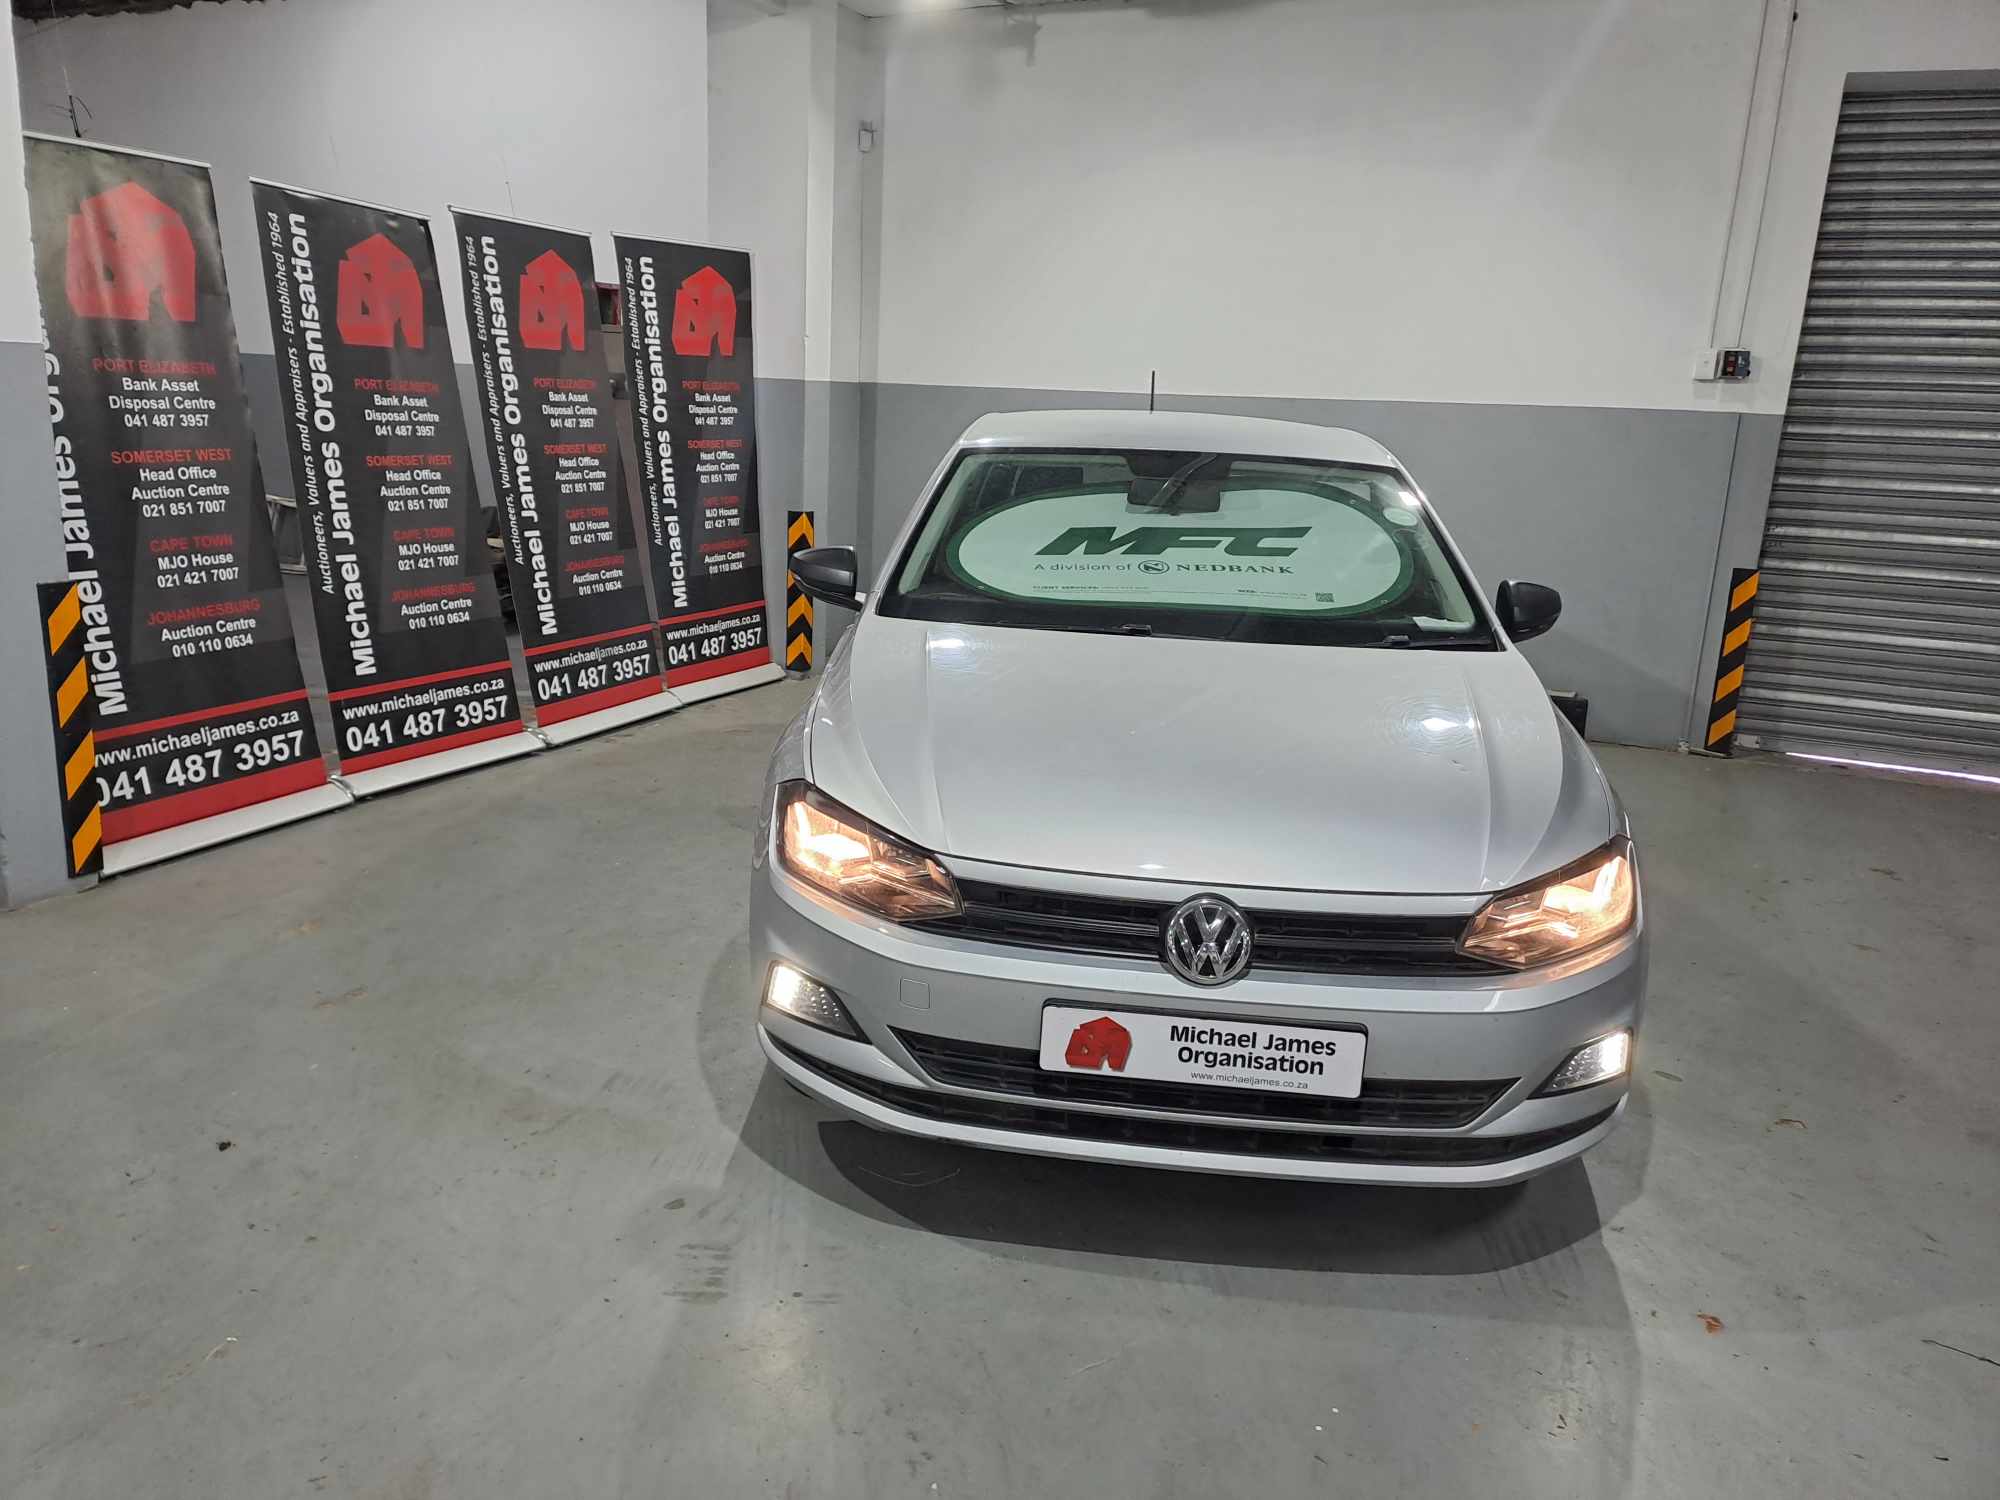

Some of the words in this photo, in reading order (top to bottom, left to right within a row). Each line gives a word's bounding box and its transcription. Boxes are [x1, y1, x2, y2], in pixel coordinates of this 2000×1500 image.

[268, 211, 282, 248] 1964
[465, 236, 477, 266] 1964
[624, 257, 634, 284] 1964
[272, 250, 294, 335] Established
[470, 270, 487, 341] Established
[289, 213, 336, 432] Organisation
[481, 236, 521, 425] Organisation
[626, 287, 640, 350] Established
[640, 256, 668, 423] Organisation
[123, 378, 157, 392] Bank
[161, 379, 200, 392] Asset
[288, 347, 308, 422] Appraisers
[482, 352, 500, 412] Appraisers
[635, 359, 648, 416] Appraisers
[109, 396, 171, 412] Disposal
[174, 398, 216, 410] Centre
[373, 394, 400, 406] Bank
[402, 396, 428, 407] Asset
[542, 404, 574, 416] Disposal
[548, 392, 567, 402] Bank
[568, 392, 588, 402] Asset
[124, 414, 148, 428] 041
[152, 414, 174, 427] 487
[180, 414, 208, 427] 3957
[364, 409, 408, 422] Disposal
[411, 410, 440, 422] Centre
[550, 418, 562, 428] 041
[640, 418, 650, 438] and
[296, 424, 311, 451] and
[375, 425, 392, 436] 041
[394, 425, 412, 436] 487
[416, 426, 434, 436] 3957
[490, 418, 502, 442] and
[112, 450, 192, 464] SOMERSET
[196, 448, 232, 462] WEST
[496, 445, 510, 489] Valuers
[559, 457, 577, 467] Head
[578, 456, 600, 466] Office
[643, 440, 655, 479] Valuers
[140, 468, 175, 481] Head
[178, 466, 216, 480] Office
[304, 454, 320, 506] Valuers
[386, 470, 411, 481] Head
[414, 470, 442, 480] Office
[511, 433, 538, 522] James
[555, 472, 582, 480] Auction
[584, 470, 606, 478] Centre
[658, 430, 678, 509] James
[55, 435, 94, 560] James
[132, 486, 186, 500] Auction
[188, 484, 230, 497] Centre
[322, 442, 354, 545] James
[380, 486, 418, 496] Auction
[421, 484, 450, 495] Centre
[561, 484, 572, 493] 021
[142, 504, 166, 518] 021
[170, 502, 193, 516] 851
[199, 500, 226, 514] 7007
[388, 501, 404, 512] 021
[407, 500, 425, 510] 851
[428, 498, 449, 509] 7007
[650, 482, 662, 546] Auctioneers,
[506, 493, 524, 565] Auctioneers,
[570, 522, 585, 532] MJO
[587, 521, 610, 530] House
[570, 535, 582, 544] 021
[584, 534, 595, 543] 421
[150, 537, 188, 553] CAPE
[193, 534, 233, 550] TOWN
[313, 511, 334, 594] Auctioneers,
[398, 544, 420, 556] MJO
[423, 542, 454, 554] House
[1034, 526, 1312, 556] MFC
[158, 556, 188, 571] MJO
[192, 552, 234, 568] House
[398, 560, 414, 571] 021
[418, 557, 434, 568] 421
[438, 555, 459, 566] 7007
[664, 516, 688, 608] Michael
[1050, 562, 1111, 571] division
[1118, 562, 1132, 571] of
[1176, 564, 1294, 574] NEDBANK
[157, 574, 181, 588] 021
[184, 571, 206, 586] 421
[211, 567, 240, 582] 7007
[524, 530, 558, 636] Michael
[572, 573, 600, 584] Auction
[600, 570, 624, 579] Centre
[578, 585, 590, 596] 010
[592, 584, 604, 593] 110
[336, 553, 376, 676] Michael
[400, 602, 438, 616] Auction
[440, 598, 472, 610] Centre
[161, 623, 212, 642] Auction
[216, 617, 256, 634] Centre
[408, 618, 426, 630] 010
[428, 614, 444, 626] 110
[447, 612, 470, 624] 0634
[666, 614, 760, 640] www.michaeljames.co.za
[68, 570, 128, 716] Michael
[172, 642, 196, 658] 010
[200, 639, 222, 654] 110
[225, 633, 254, 650] 0634
[534, 640, 648, 672] www.michaeljames.co.za
[668, 642, 696, 664] 041
[701, 636, 726, 656] 487
[730, 628, 762, 650] 3957
[538, 673, 571, 700] 041
[578, 664, 606, 690] 487
[612, 654, 650, 681] 3957
[342, 678, 504, 720] www.michaeljames.co.za
[346, 720, 393, 752] 041
[403, 708, 446, 738] 487
[454, 695, 508, 727] 3957
[94, 710, 300, 768] ww.michaeljames.co.za
[166, 750, 222, 787] 487
[234, 730, 304, 771] 3957
[1170, 1025, 1258, 1049] Michael
[1263, 1034, 1337, 1056] James
[1178, 1046, 1324, 1075] Organisation
[1190, 1072, 1308, 1090] www.michaeljames.co.za
